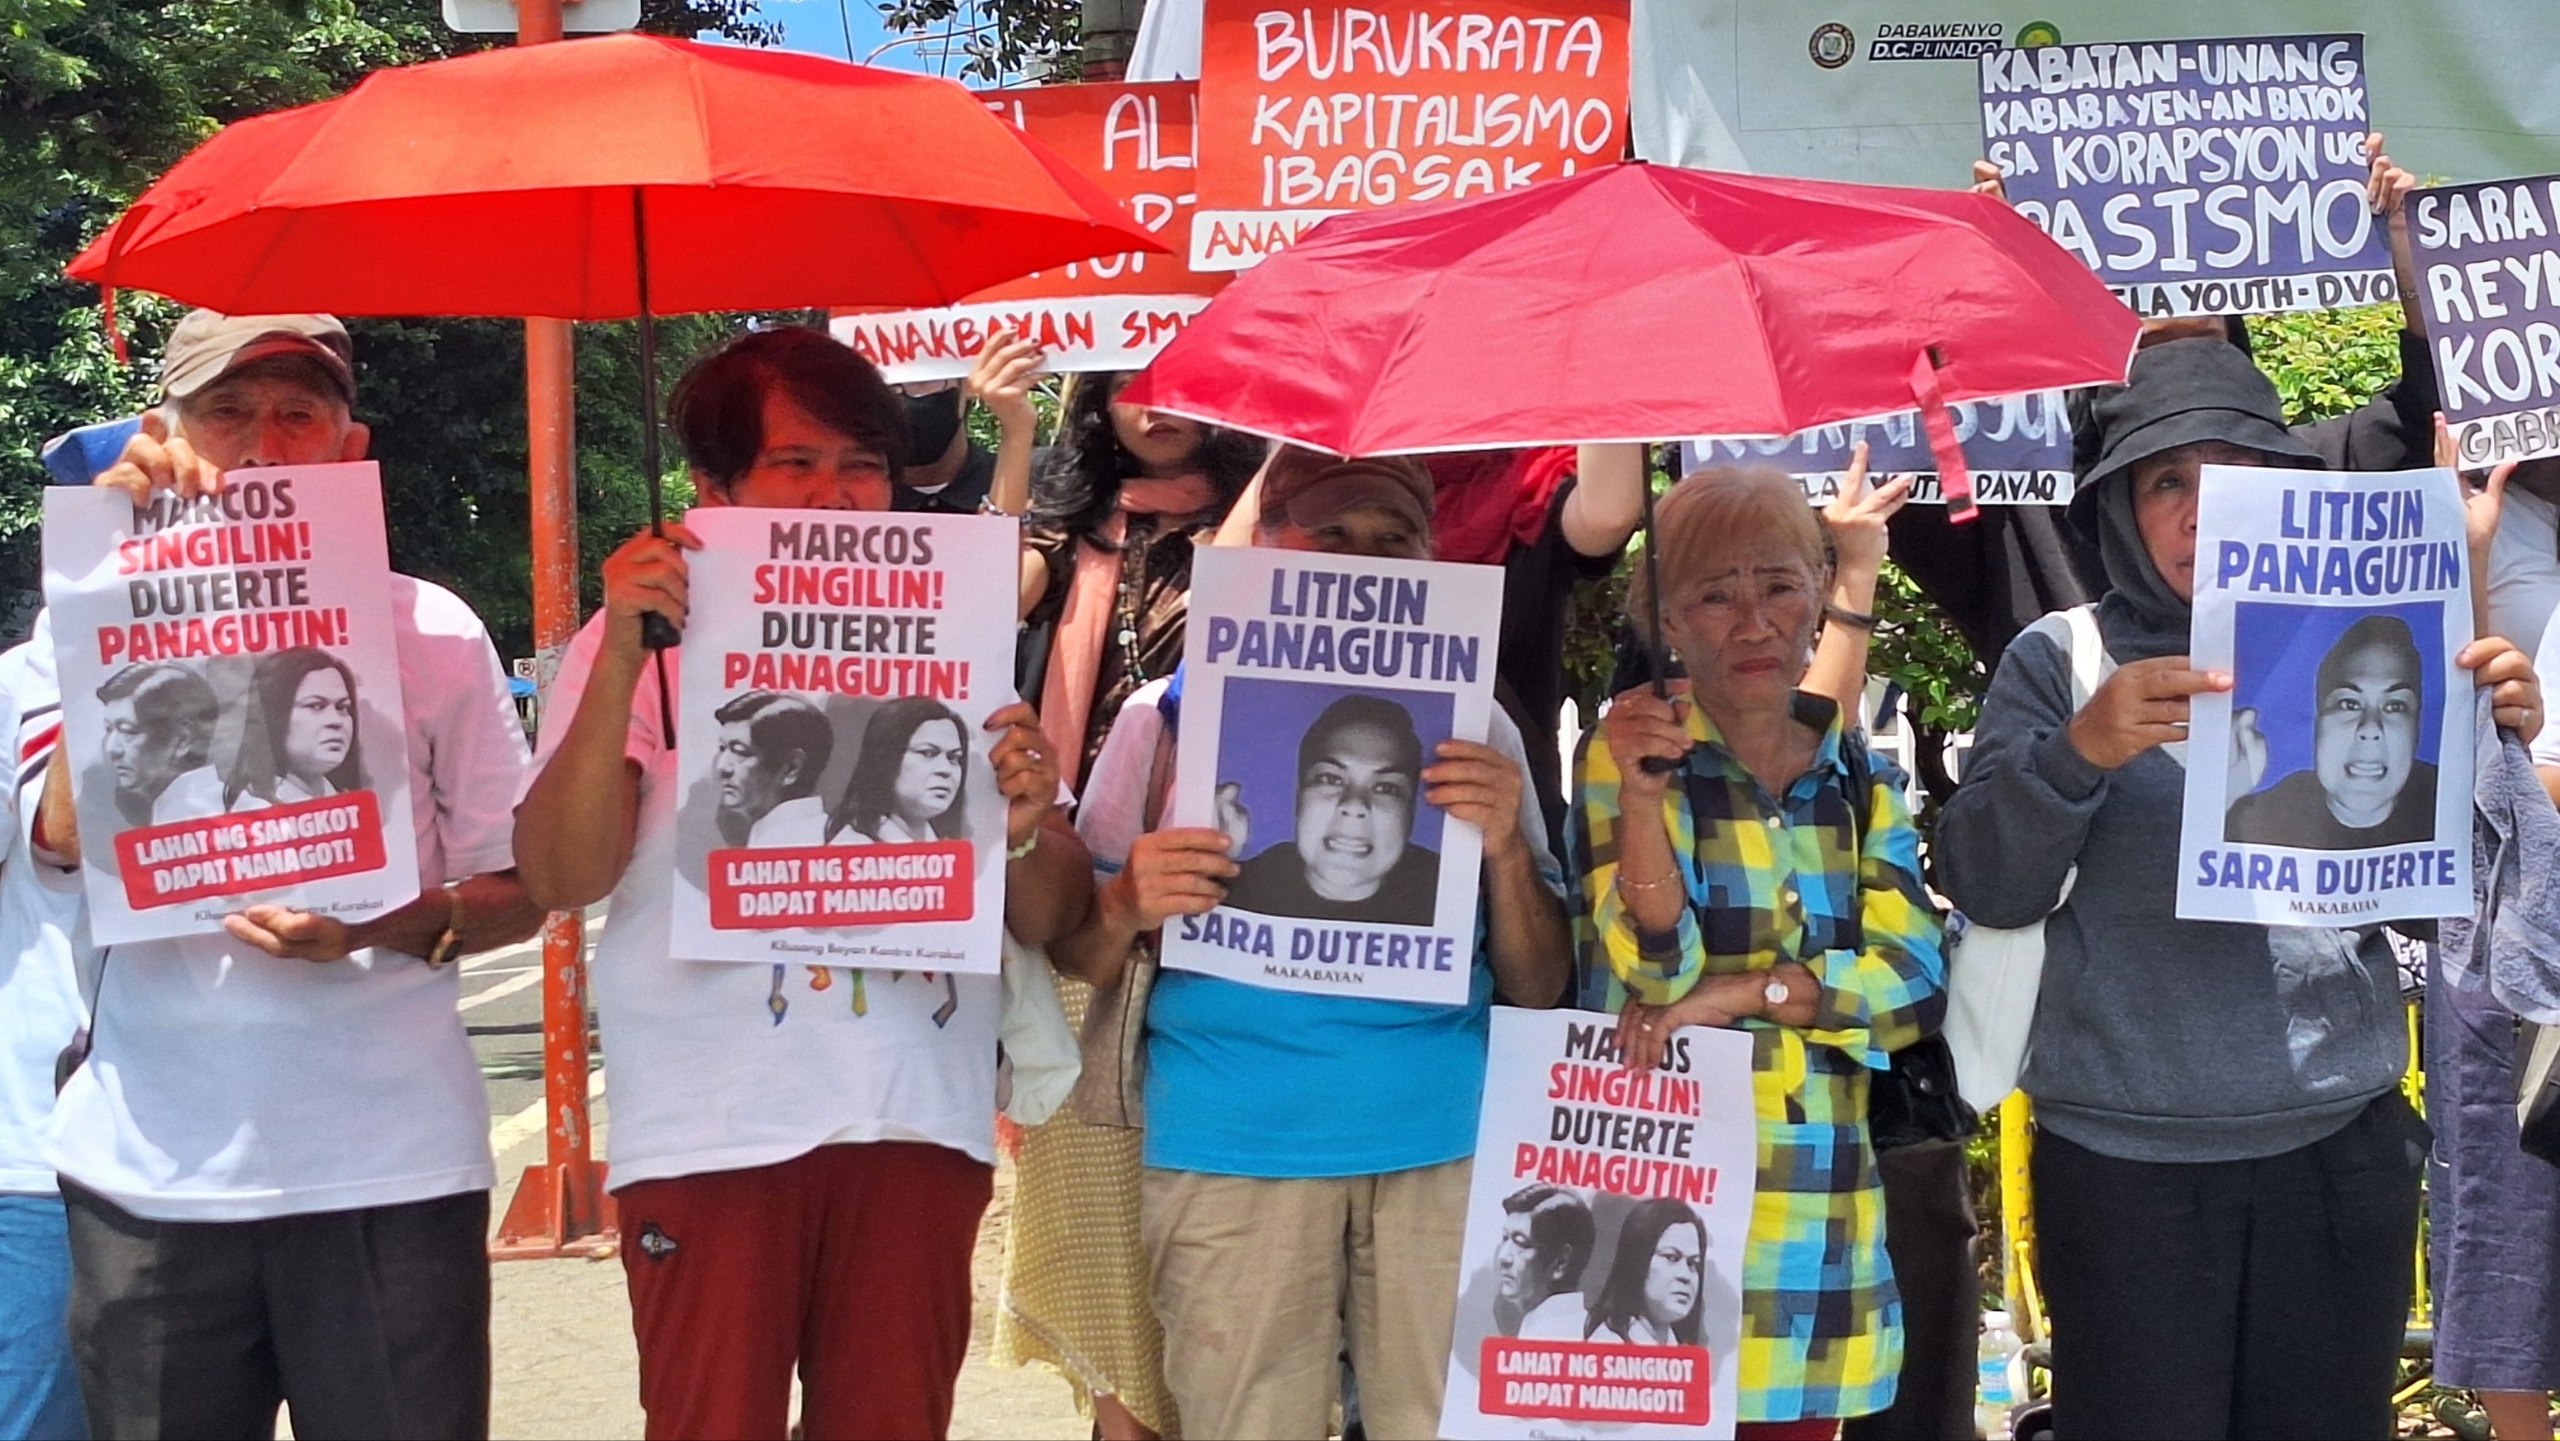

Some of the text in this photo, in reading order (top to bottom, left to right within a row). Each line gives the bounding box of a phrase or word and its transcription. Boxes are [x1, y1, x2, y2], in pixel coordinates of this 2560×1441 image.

[1254, 8, 1602, 81] BURUKRATA
[1878, 24, 2003, 39] DABAWENYO
[1982, 41, 2357, 94] KABATAN-UNANG
[1251, 92, 1613, 154] KAPITALISMO
[2268, 84, 2367, 122] BATOK
[1988, 140, 2039, 176] SA
[2053, 126, 2319, 189] KORAPSYON
[2417, 185, 2548, 250] SARA
[2120, 284, 2175, 318] LA
[1975, 474, 2056, 501] DAVAO
[2280, 489, 2424, 541] LITISIN
[118, 521, 311, 576] SINGILIN!
[769, 521, 934, 566] MARCOS
[2217, 540, 2461, 597] PANAGUTIN
[129, 566, 310, 619] DUTERTE
[753, 564, 944, 610] SINGILIN!
[1270, 567, 1429, 626] LITISIN
[97, 607, 350, 666] PANAGUTIN!
[762, 610, 936, 655] DUTERTE
[1206, 615, 1480, 683] PANAGUTIN
[724, 652, 970, 700] PANAGUTIN!
[134, 804, 360, 866] LAHAT NG SANGKOT
[153, 837, 356, 895] DAPAT MANAGOT!
[727, 853, 956, 886] LAHAT NG SANGKOT
[2197, 849, 2455, 895] SARA DUTERTE
[739, 884, 945, 917] DAPAT MANAGOT!
[2288, 898, 2381, 914] MAKABAYAN
[1179, 911, 1455, 972] SARA DUTERTE
[1263, 963, 1364, 984] MAKABAYAN
[1548, 1062, 1700, 1117] SINGILIN!
[1550, 1105, 1695, 1158] DUTERTE
[1514, 1142, 1718, 1204] PANAGUTIN!
[1496, 1350, 1694, 1383] LAHAT NG SANGKOT
[1505, 1380, 1686, 1414] DAPAT MANAGOT!
